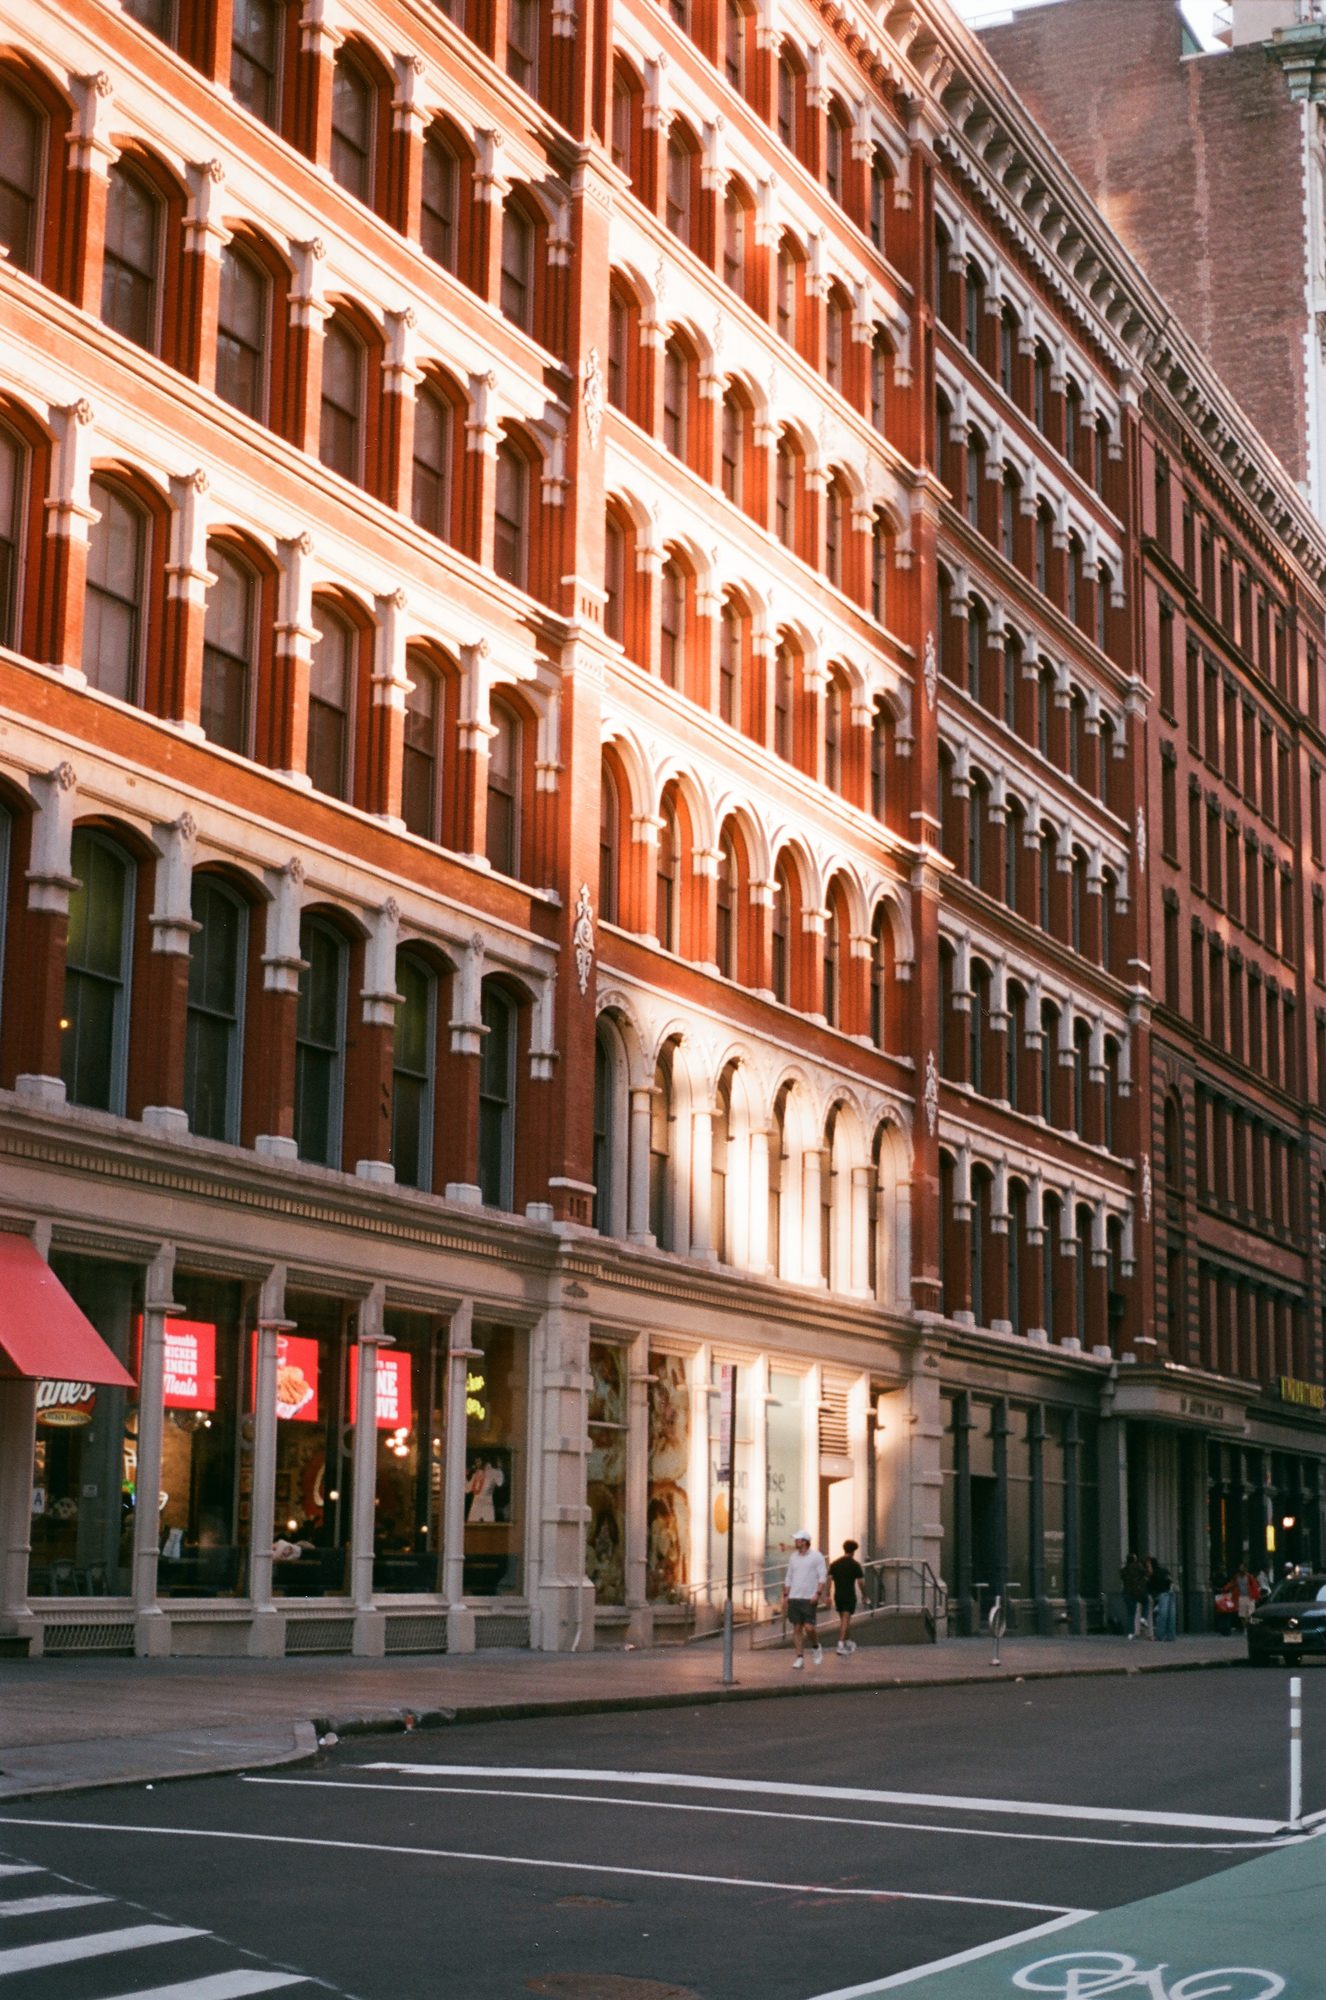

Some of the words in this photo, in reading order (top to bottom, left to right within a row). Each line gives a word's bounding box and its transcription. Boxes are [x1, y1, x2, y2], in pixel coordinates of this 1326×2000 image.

[164, 1345, 198, 1361] HICKEN
[164, 1358, 198, 1375] INGER
[376, 1370, 398, 1397] NE
[376, 1396, 399, 1419] OVE
[34, 1491, 42, 1505] A
[733, 1497, 786, 1527] Baels
